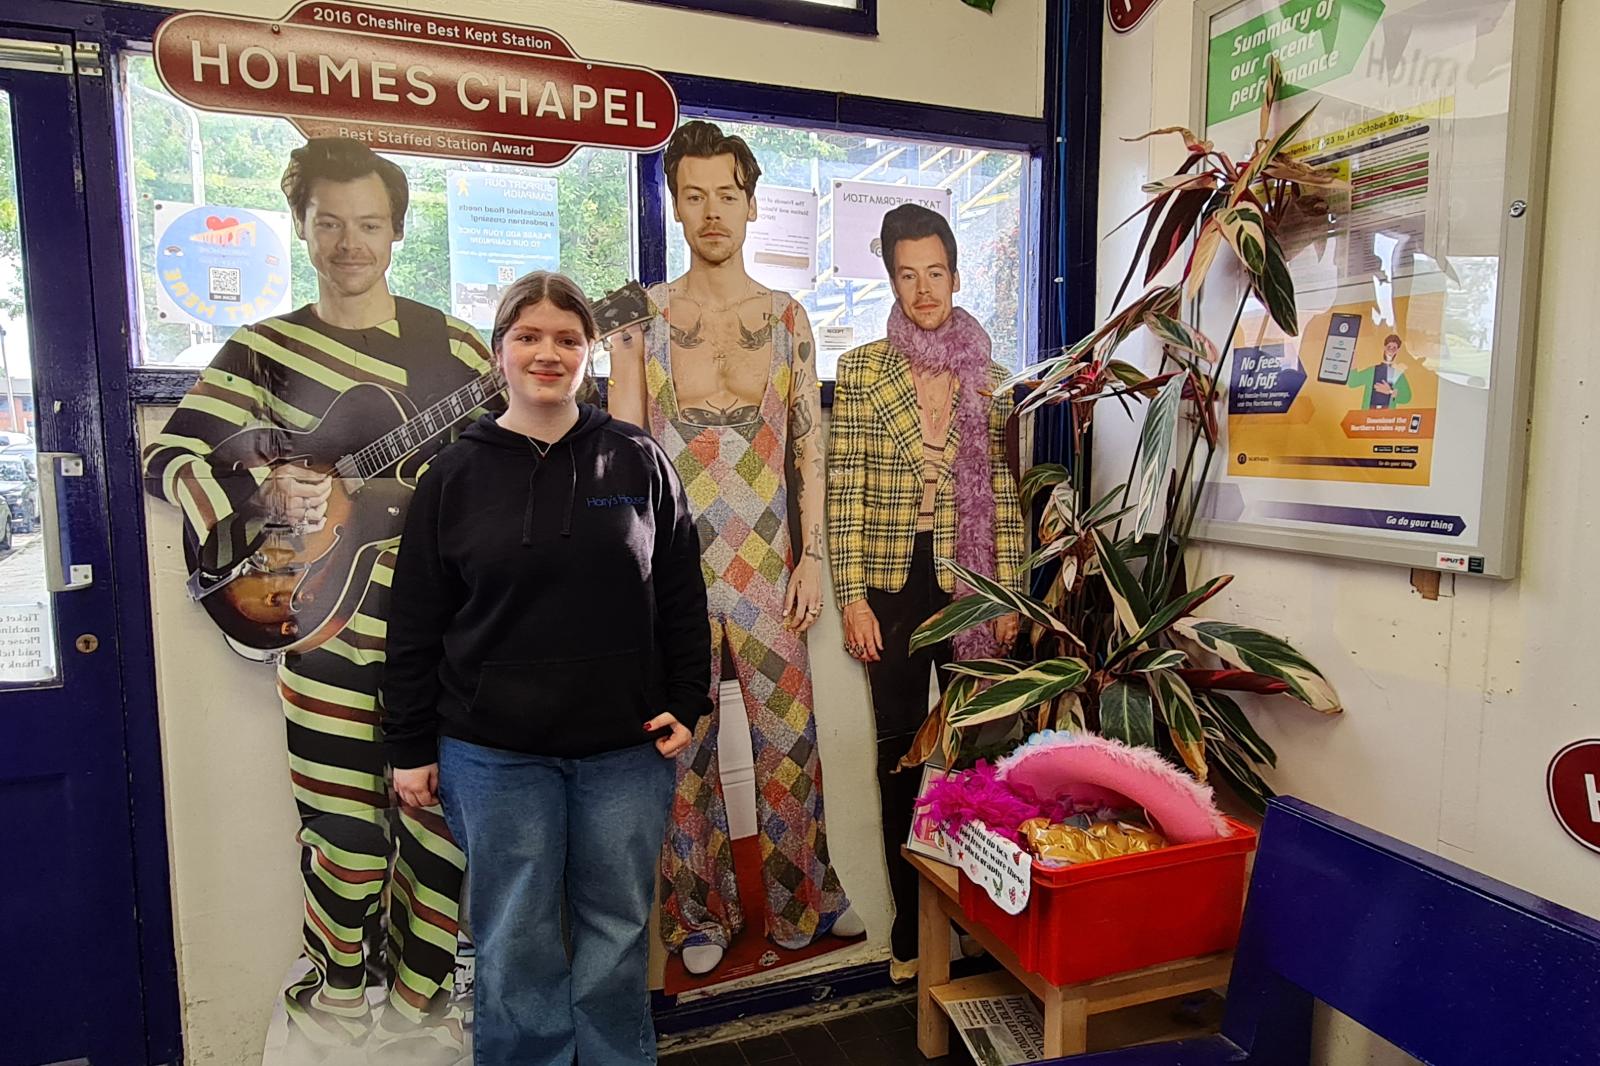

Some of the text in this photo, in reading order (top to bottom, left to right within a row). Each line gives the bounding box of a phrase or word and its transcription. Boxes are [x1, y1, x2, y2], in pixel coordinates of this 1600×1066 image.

[313, 8, 551, 50] 2016 Cheshire Best Kept Station
[1231, 0, 1335, 57] Summary of
[1230, 29, 1319, 81] our recent
[191, 40, 657, 129] HOLMES CHAPEL
[1230, 49, 1339, 112] perfomance
[1357, 119, 1387, 135] October
[339, 128, 534, 157] Best Staffed Station Award
[1240, 356, 1255, 371] No
[1238, 371, 1278, 390] No faff.
[1386, 515, 1454, 532] Go do your thing
[996, 841, 1009, 861] box
